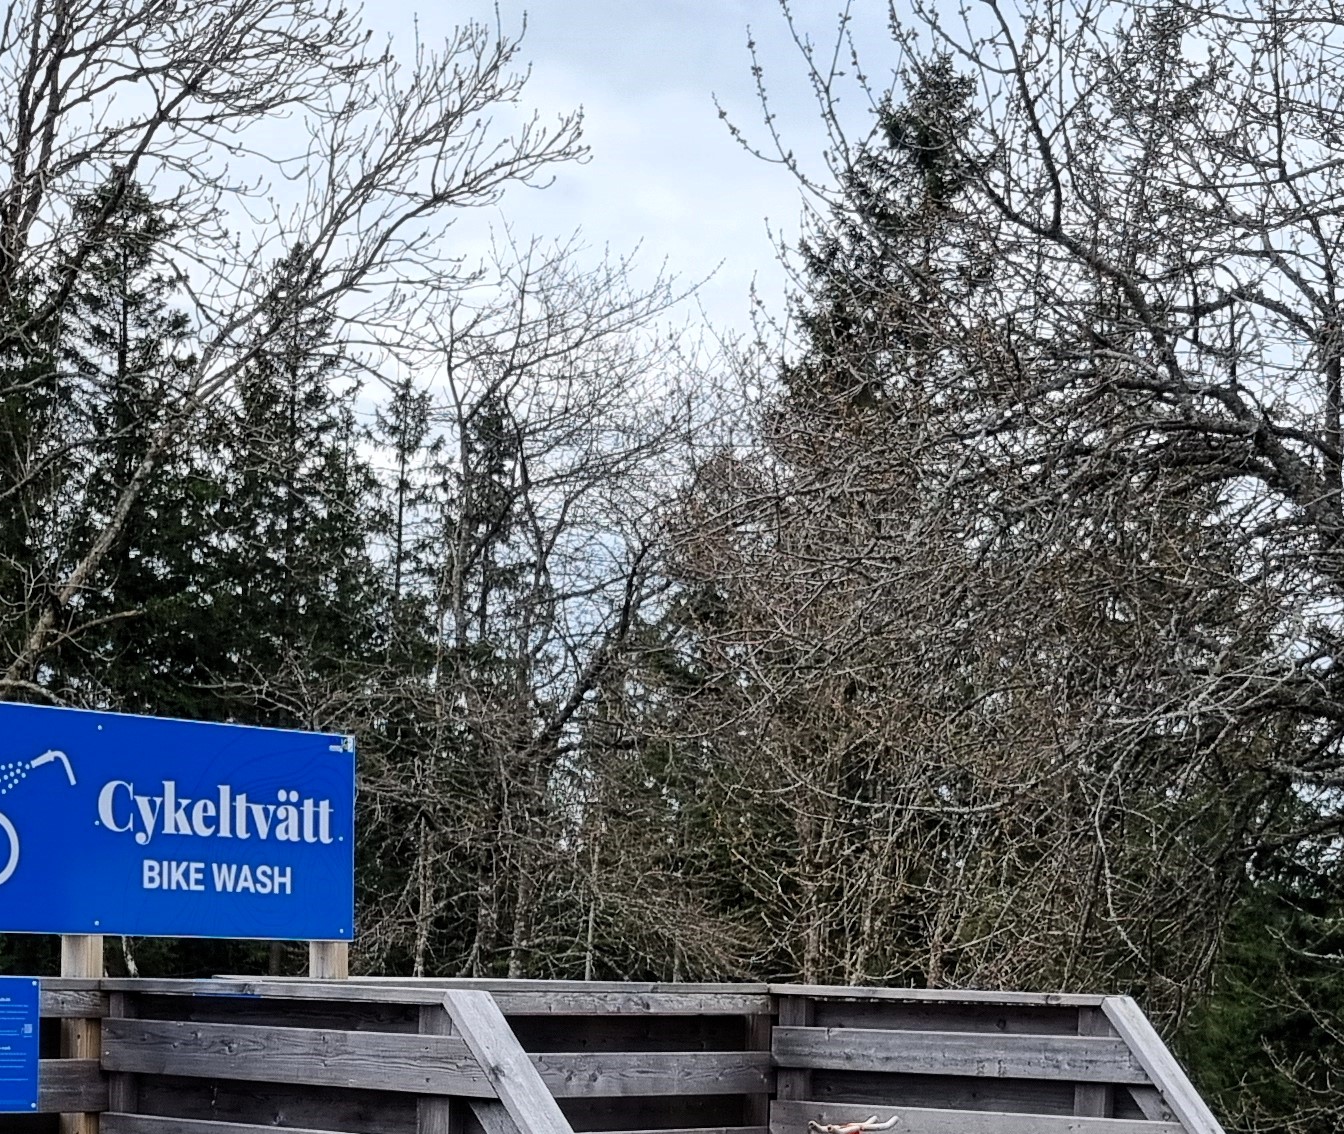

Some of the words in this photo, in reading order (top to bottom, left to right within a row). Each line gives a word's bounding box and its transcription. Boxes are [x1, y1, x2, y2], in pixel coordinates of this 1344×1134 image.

[98, 781, 333, 844] Cykeltvätt
[144, 860, 204, 890] BIKE
[212, 864, 291, 893] WASH
